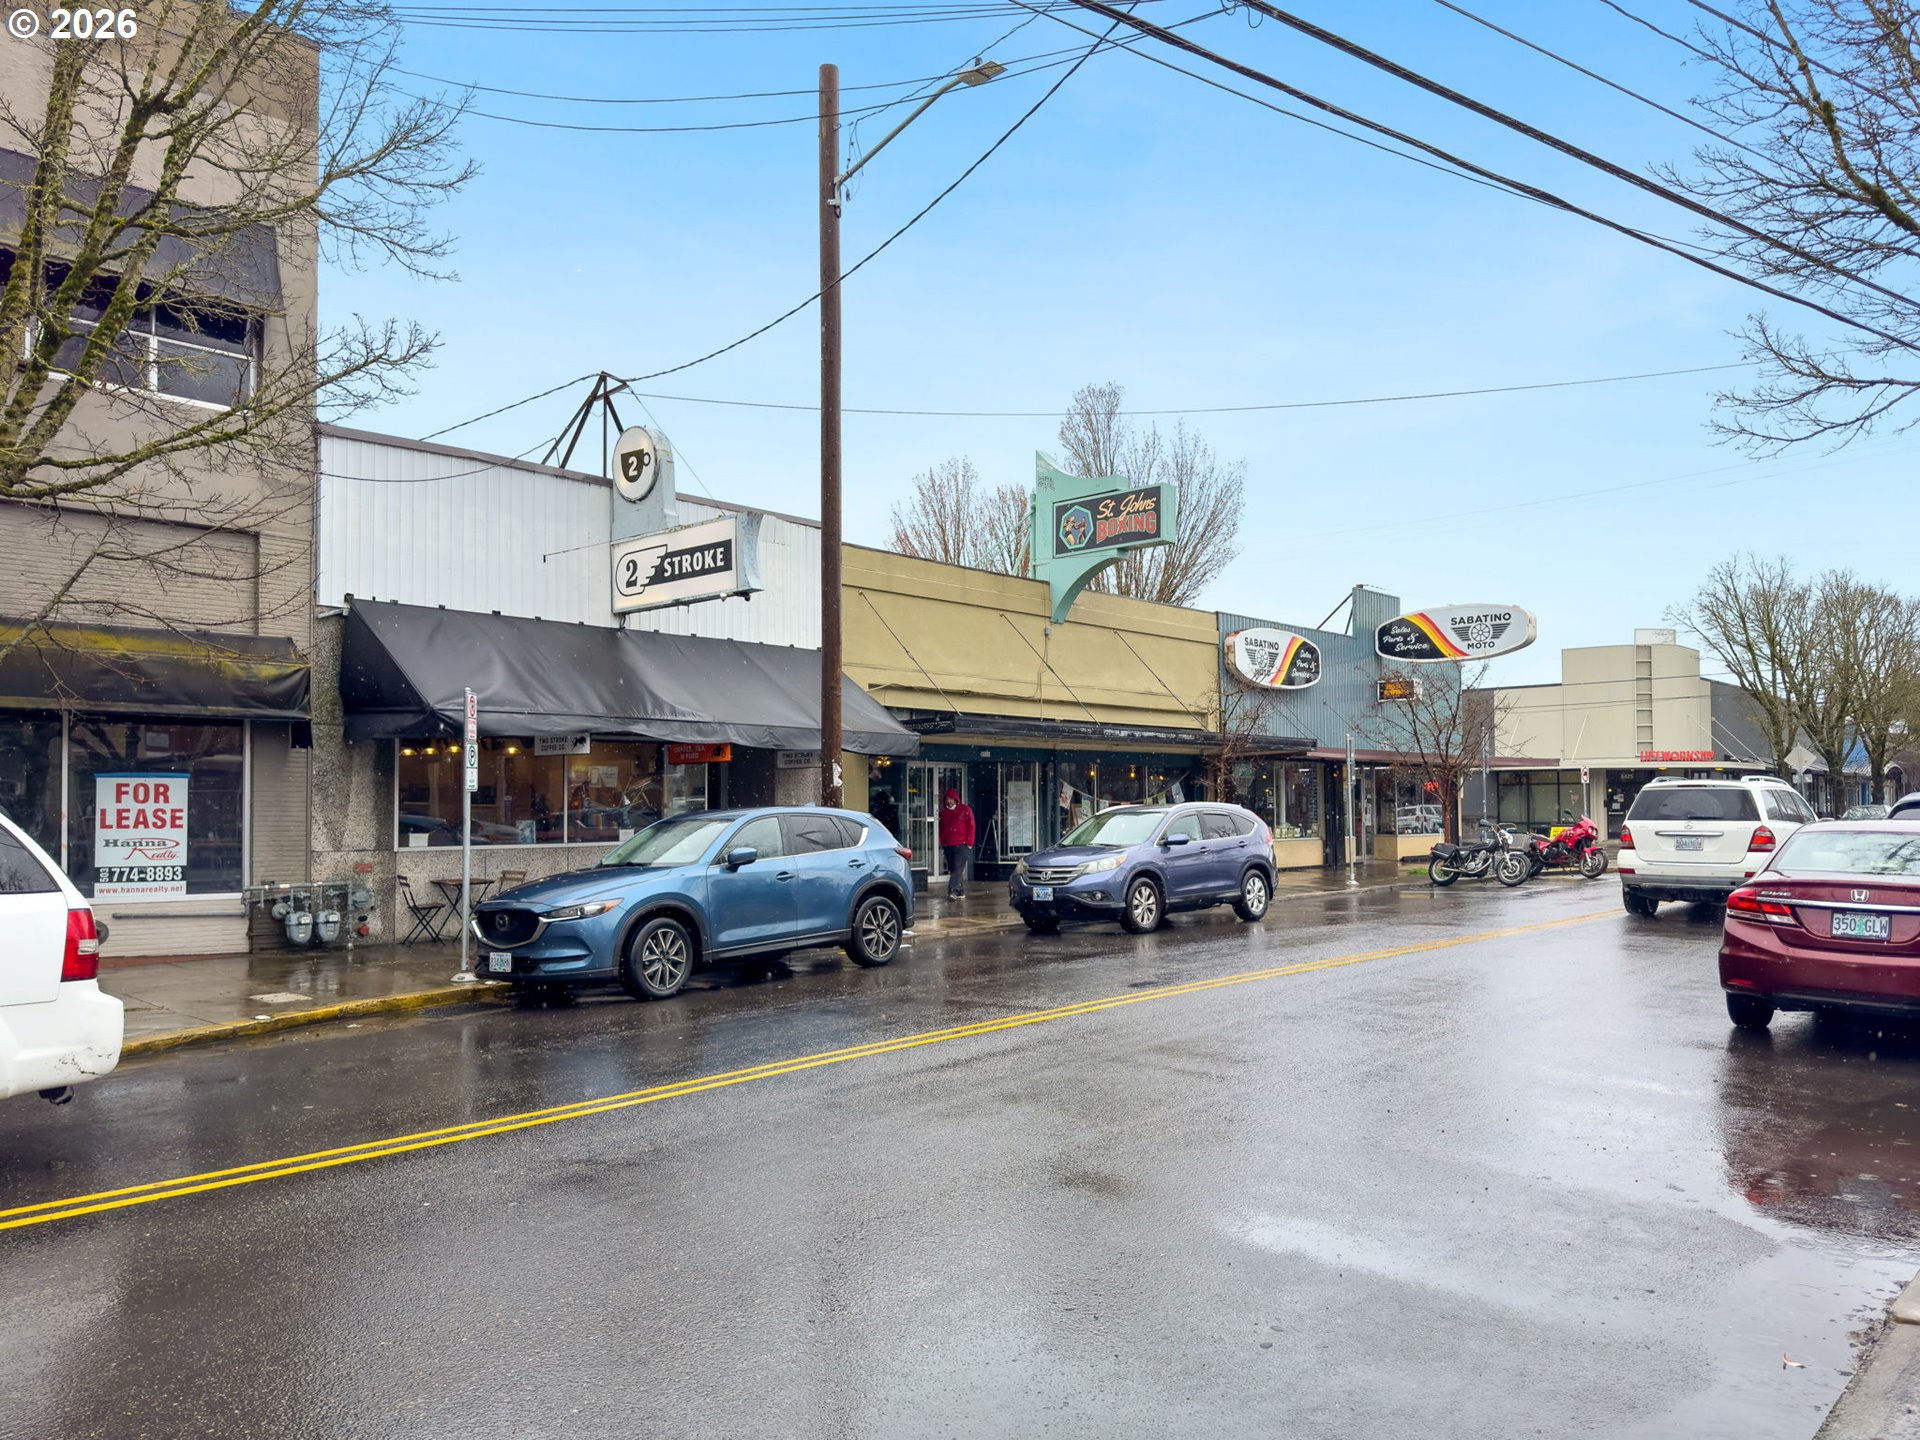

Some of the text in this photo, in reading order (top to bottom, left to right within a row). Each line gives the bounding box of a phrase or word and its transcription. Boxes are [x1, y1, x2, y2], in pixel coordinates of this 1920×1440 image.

[628, 456, 638, 477] 2
[1096, 492, 1157, 520] St. Johns
[1096, 511, 1157, 544] BOXING
[625, 547, 725, 588] 2 STROKE
[1450, 612, 1512, 626] SABATINO
[1390, 626, 1410, 634] Sales
[1244, 637, 1280, 651] SABATINO
[1383, 633, 1419, 644] Parts &
[1467, 641, 1496, 650] MOTO
[1394, 643, 1430, 652] Service
[539, 735, 568, 744] TWO STROKE
[115, 783, 170, 804] FOR
[100, 808, 184, 829] LEASE
[103, 839, 167, 848] Hanna
[123, 845, 179, 860] Realty
[100, 866, 182, 883] 503 774-8893
[97, 885, 183, 895] www.hannarealty.net
[1833, 917, 1889, 934] 350 GLW
